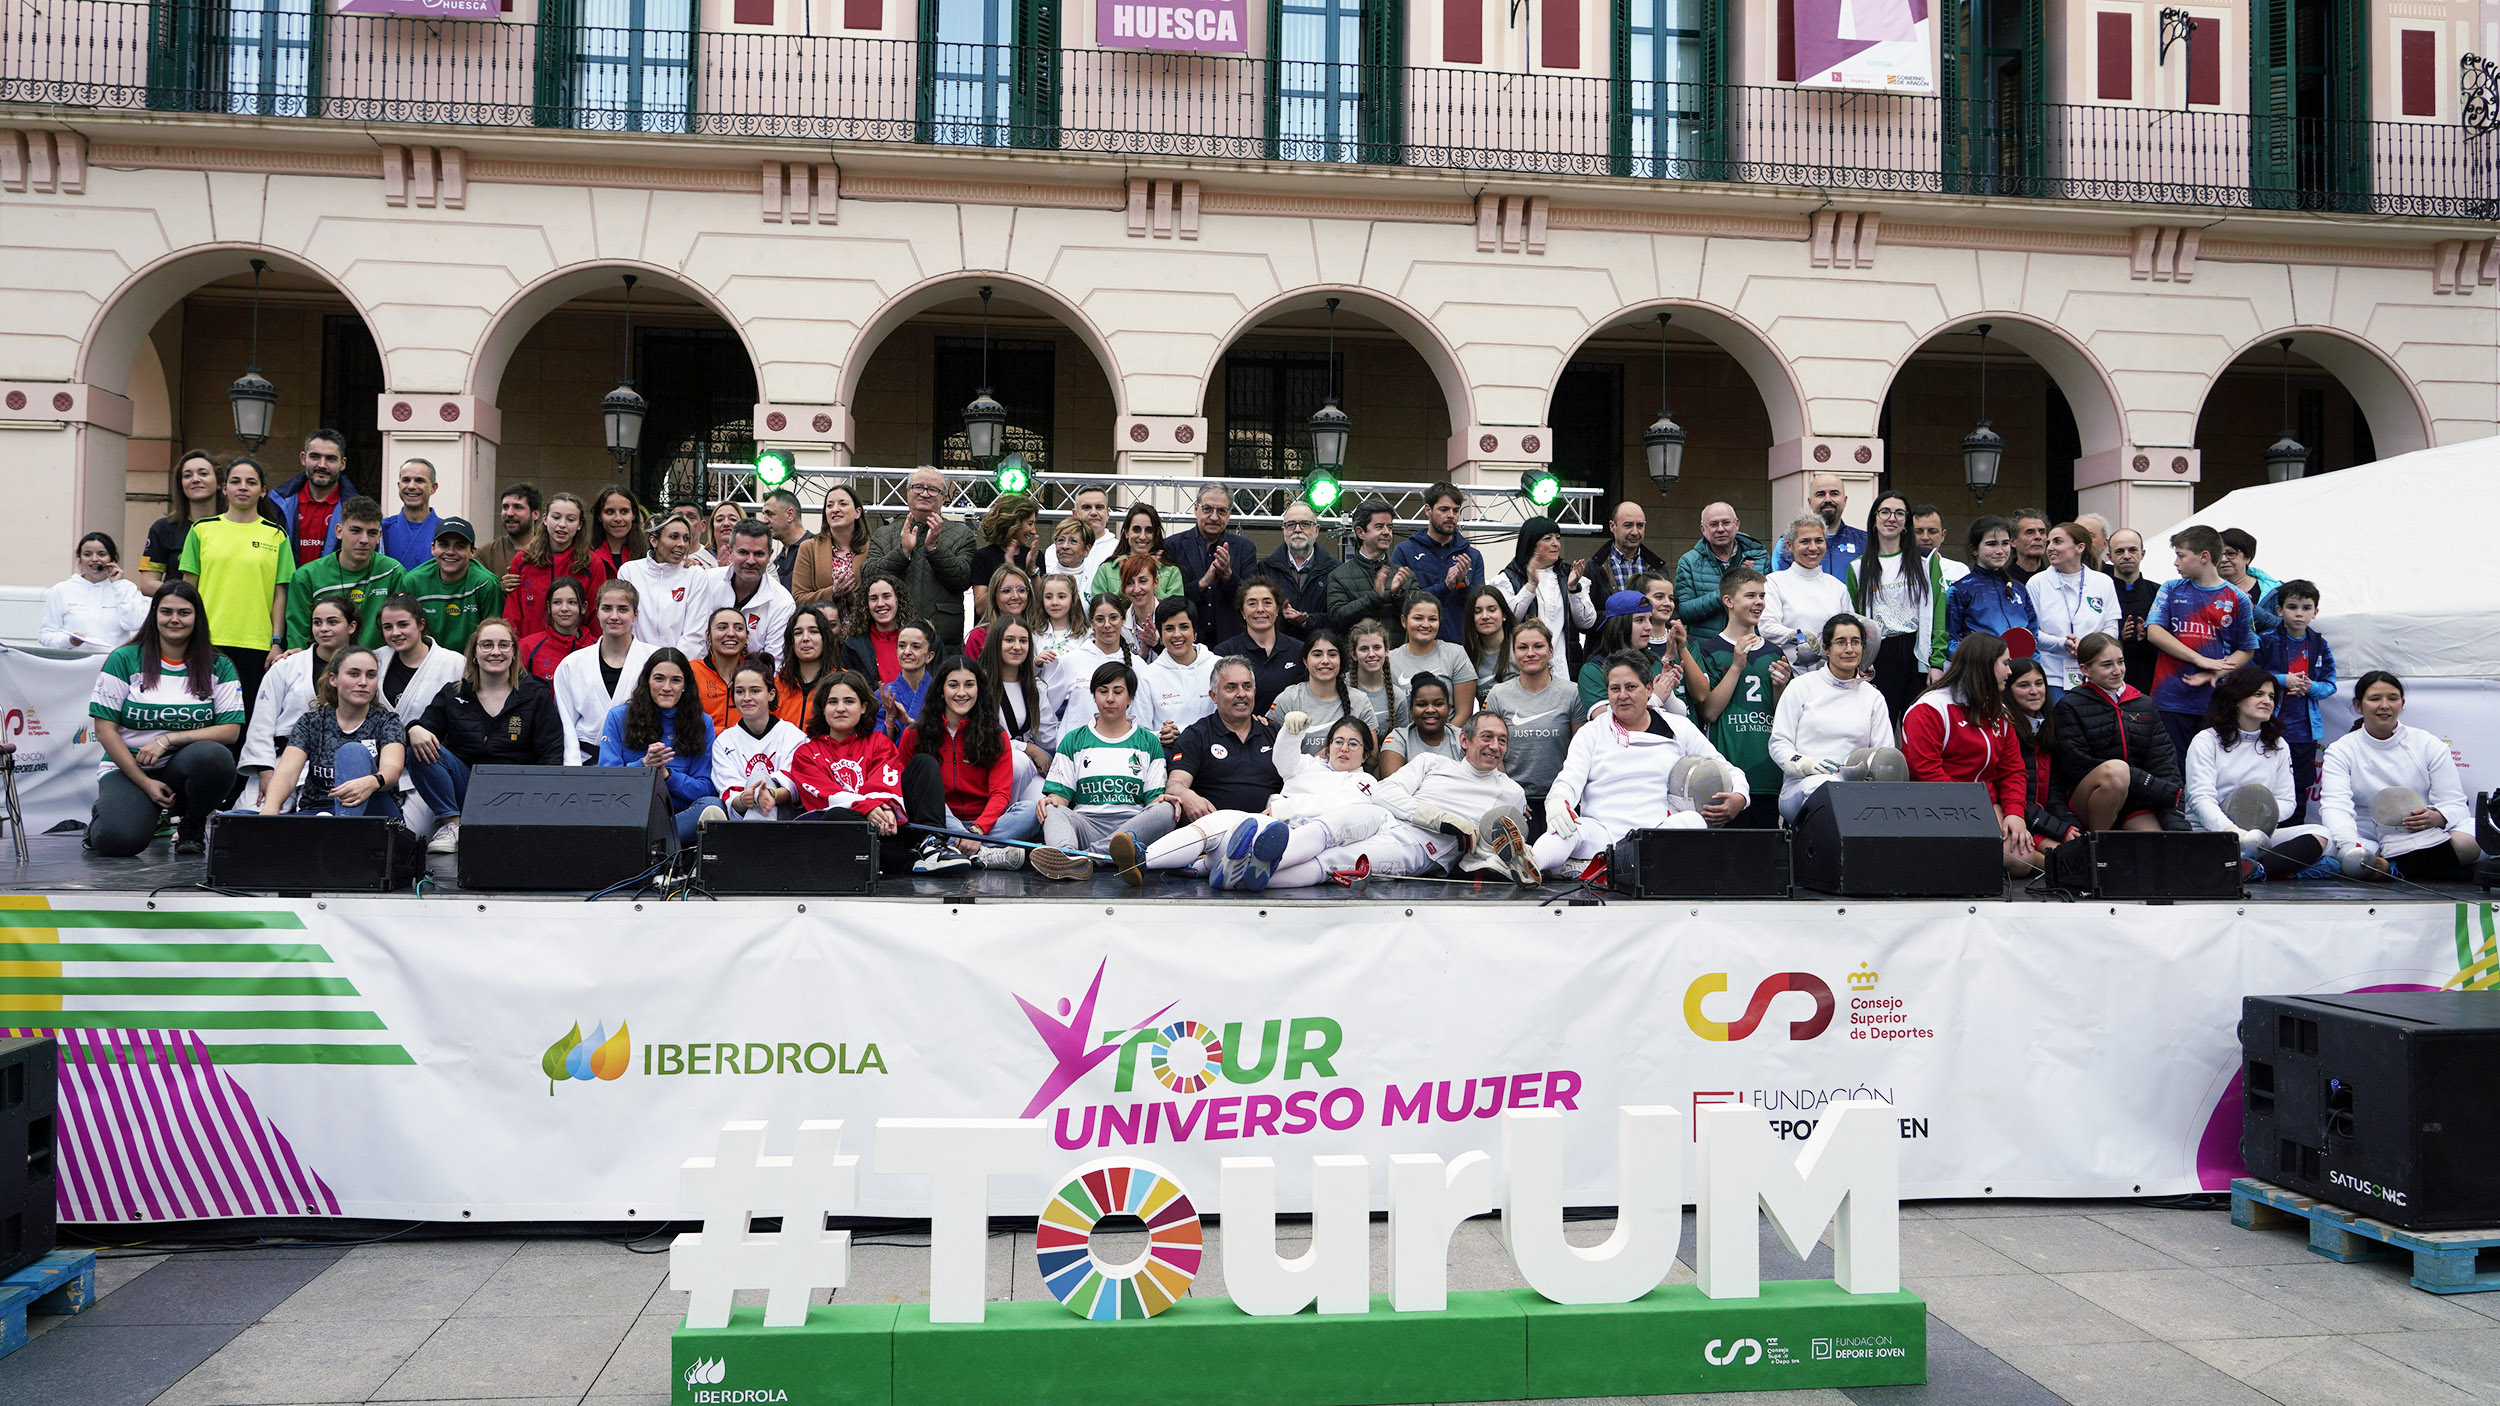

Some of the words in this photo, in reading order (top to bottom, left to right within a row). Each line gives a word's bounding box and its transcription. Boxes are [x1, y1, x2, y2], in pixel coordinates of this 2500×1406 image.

[442, 2, 488, 11] HUESCA
[1113, 5, 1238, 42] HUESCA
[1744, 675, 1762, 702] 2
[1514, 729, 1534, 738] JUST
[1536, 730, 1550, 738] DO
[1305, 737, 1325, 746] JUST
[532, 792, 632, 808] MARK
[1892, 807, 1981, 821] MARK
[1850, 996, 1903, 1011] Consejo
[1850, 1012, 1907, 1026] Superior
[1850, 1028, 1867, 1039] de
[1871, 1027, 1934, 1041] Deportes
[644, 1042, 888, 1075] IBERDROLA
[1101, 1016, 1343, 1094] TOUR
[1053, 1087, 1365, 1151] UNIVERSO
[1381, 1069, 1583, 1127] MUJER
[1875, 1347, 1905, 1358] JOVEN
[694, 1389, 788, 1404] IBERDROLA
